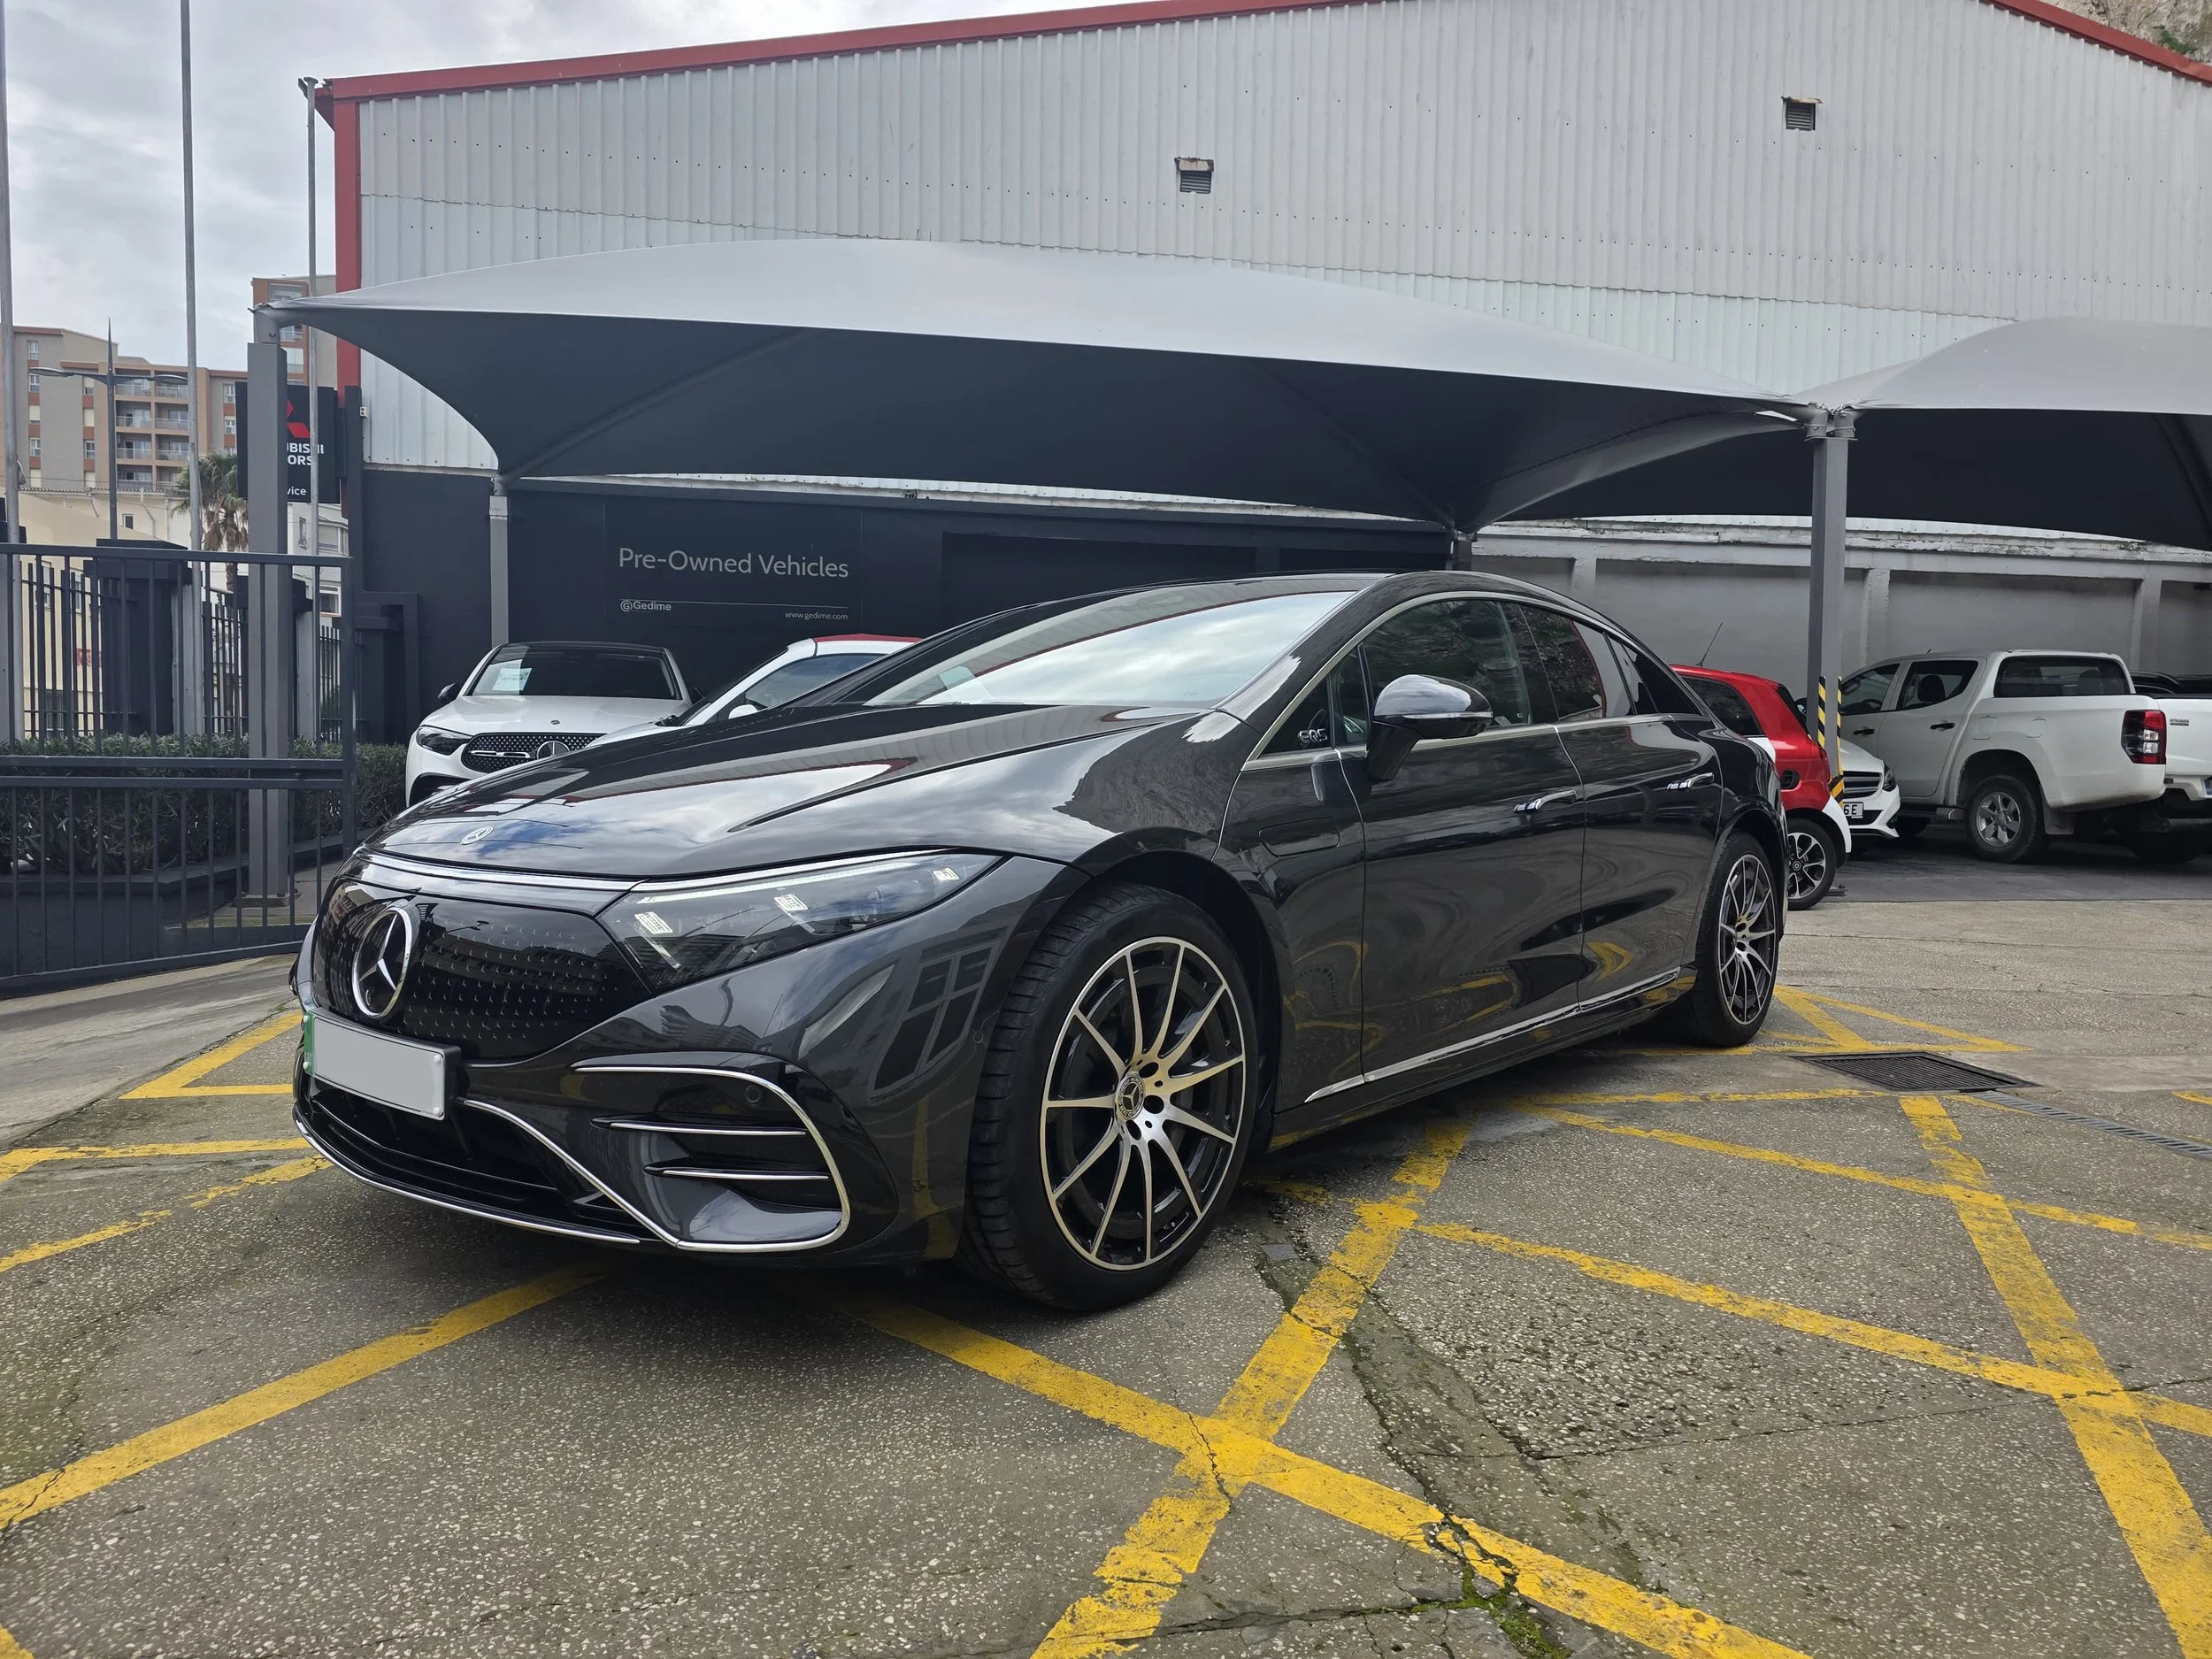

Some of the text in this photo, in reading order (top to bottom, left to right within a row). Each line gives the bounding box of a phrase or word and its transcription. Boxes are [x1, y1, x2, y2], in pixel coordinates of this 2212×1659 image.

[619, 547, 849, 578] Pre-Owned Vehicles
[785, 611, 849, 621] www.gedime.com
